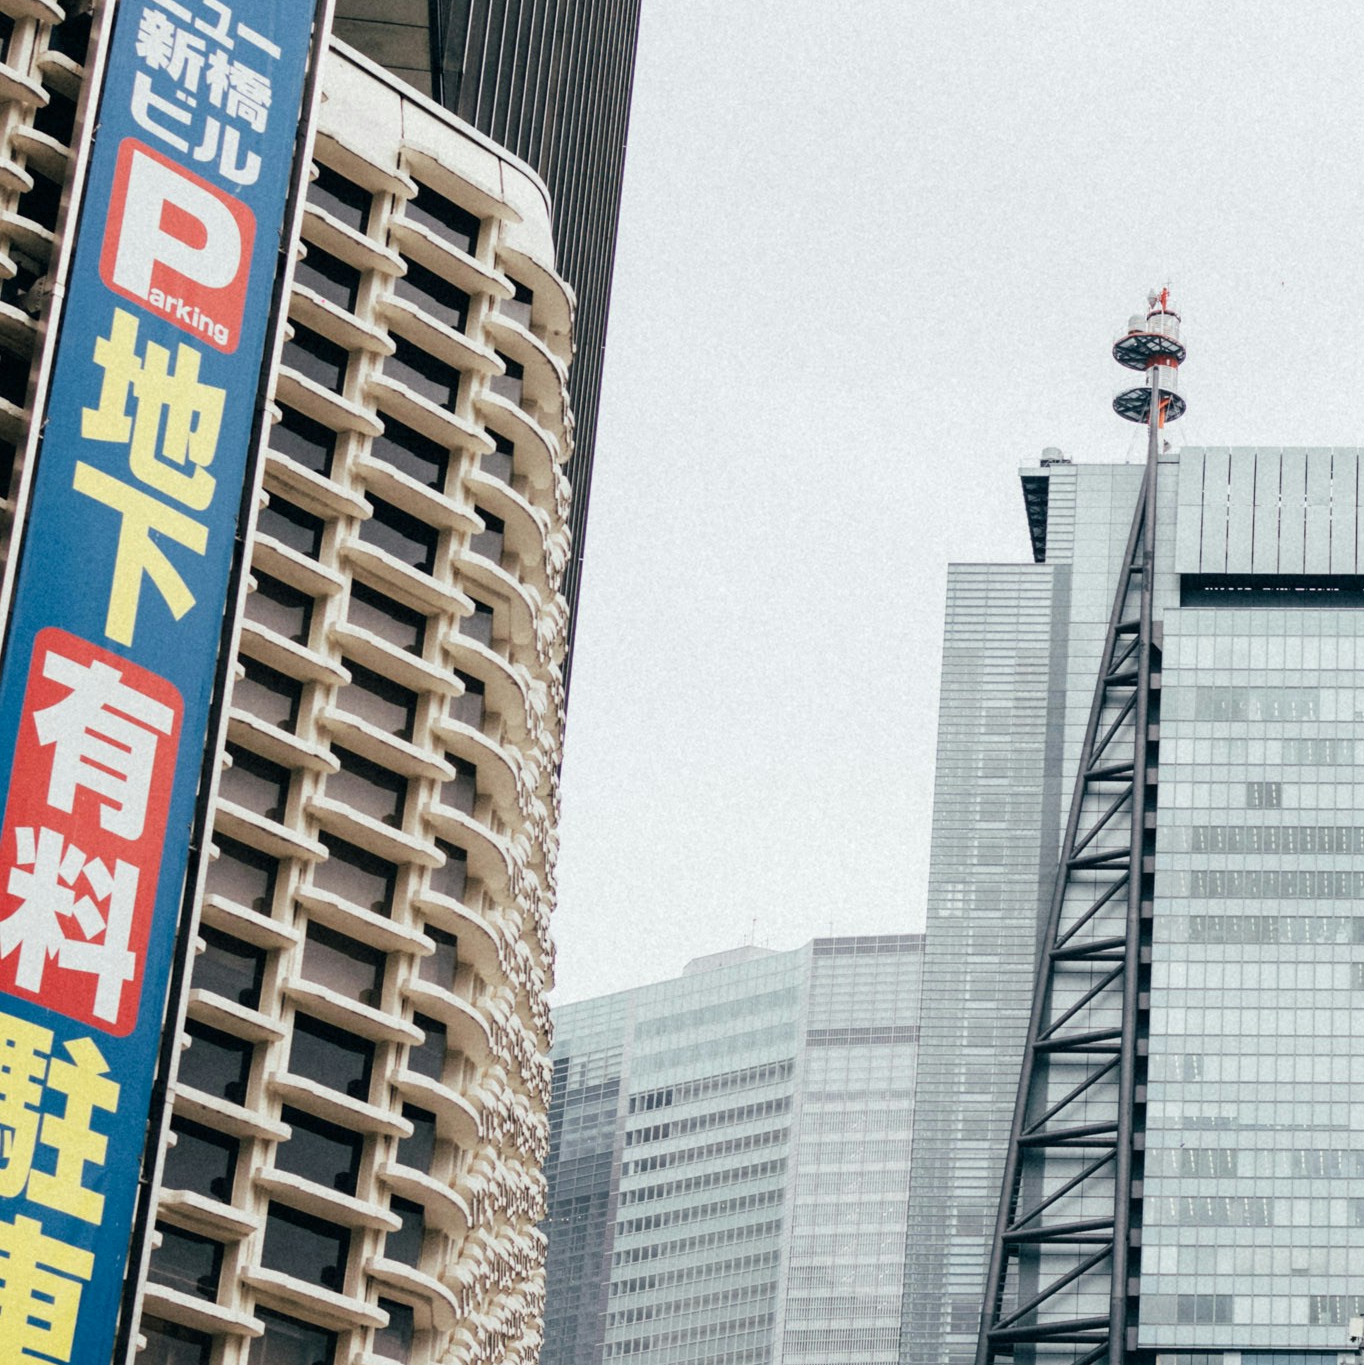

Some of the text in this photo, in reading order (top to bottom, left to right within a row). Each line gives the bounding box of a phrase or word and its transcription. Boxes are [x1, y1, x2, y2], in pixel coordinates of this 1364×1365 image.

[131, 70, 261, 185] ビル
[135, 7, 272, 133] 新橋
[71, 307, 226, 648] 地下
[0, 650, 174, 1024] 有料
